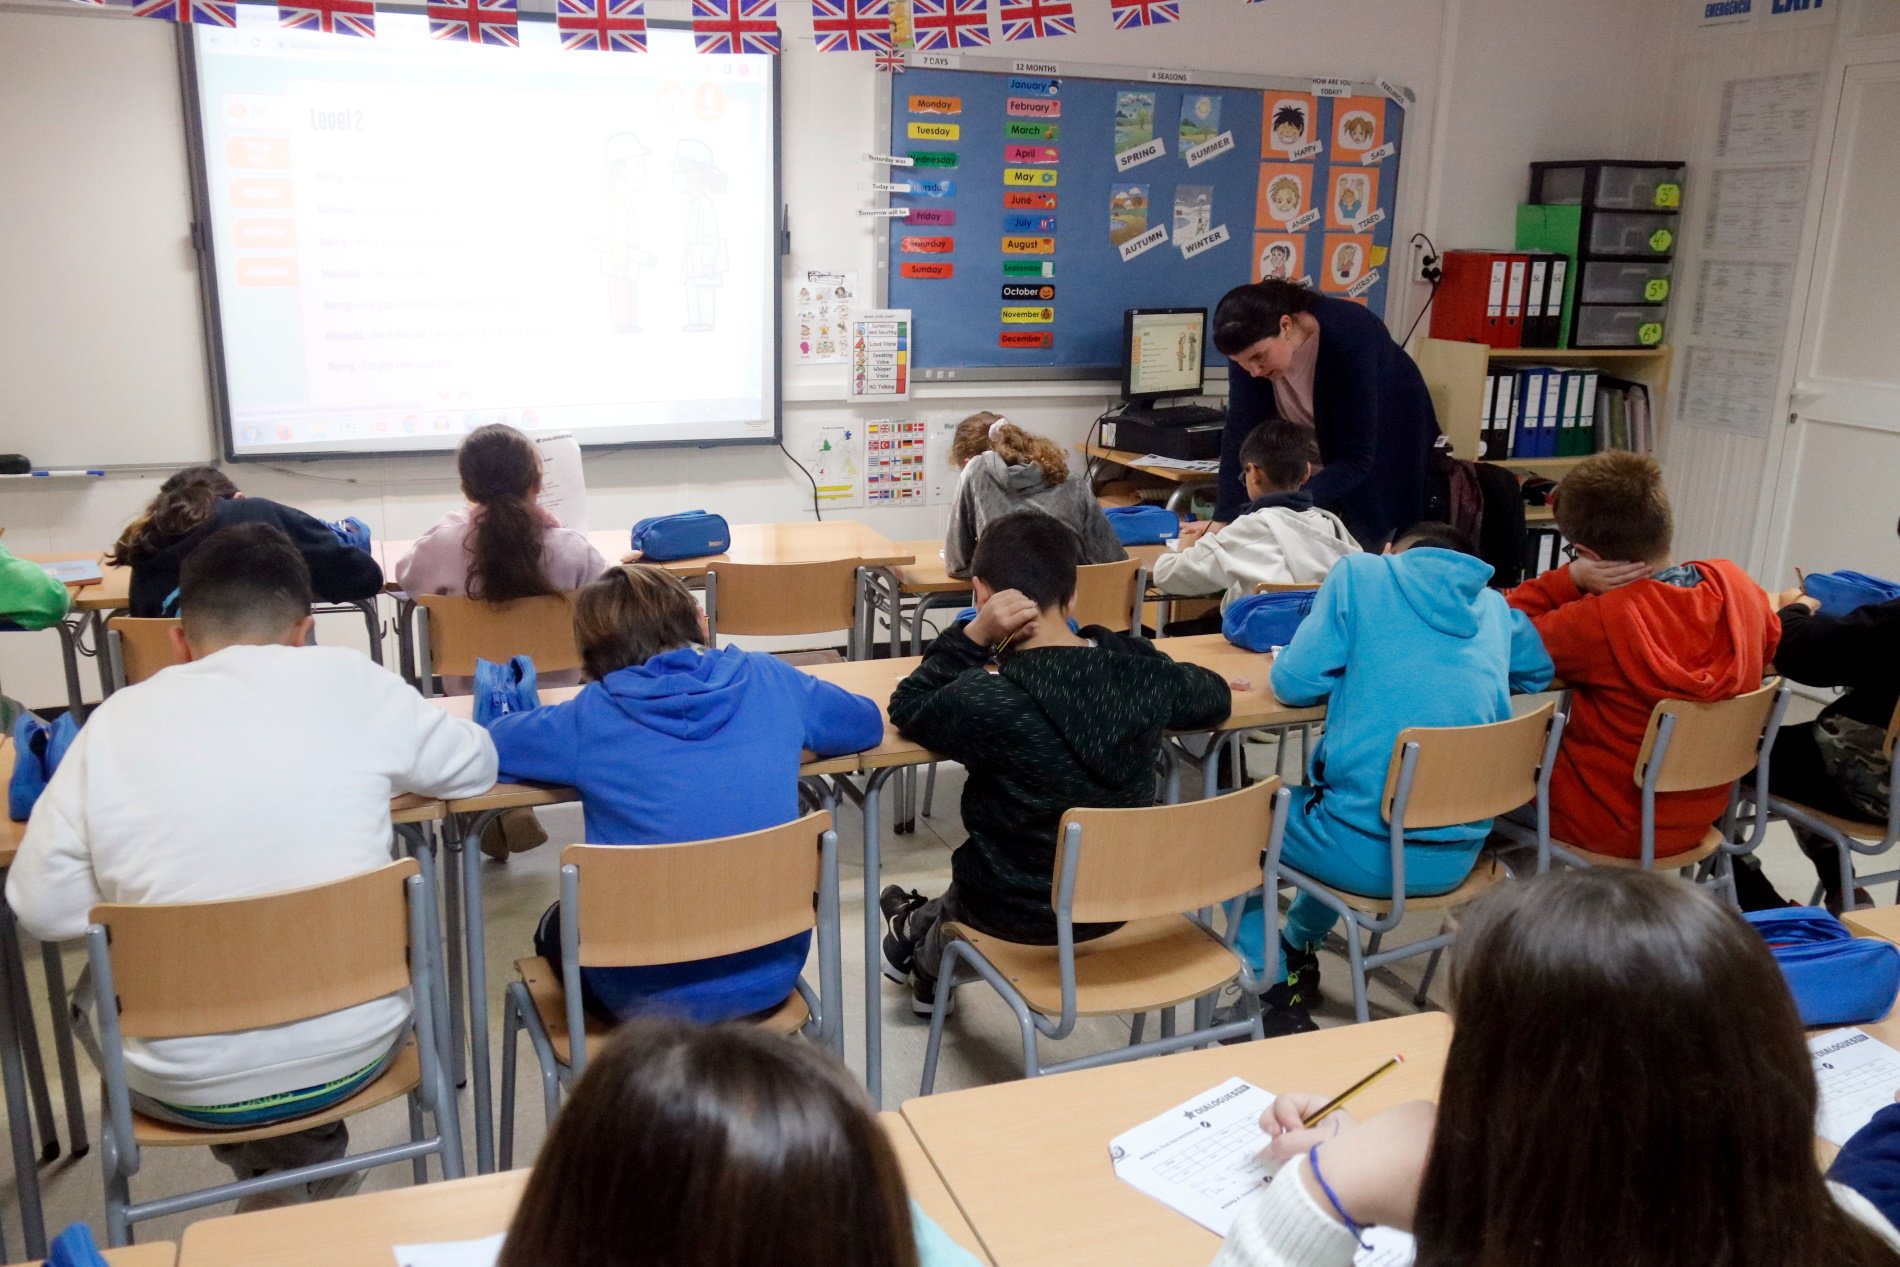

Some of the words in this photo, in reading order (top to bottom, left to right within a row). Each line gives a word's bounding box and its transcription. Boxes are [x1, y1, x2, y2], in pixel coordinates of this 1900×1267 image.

[923, 57, 929, 65] 7
[930, 57, 949, 66] DAYS
[1016, 63, 1025, 71] 12
[1026, 64, 1057, 73] MONTHS
[1157, 72, 1187, 81] SEASONS
[1010, 80, 1047, 91] January
[1380, 81, 1404, 104] FEELINGS
[917, 99, 952, 110] Monday
[1010, 101, 1050, 113] February
[310, 106, 351, 131] Level
[354, 109, 364, 131] 2
[916, 126, 951, 137] Tuesday
[1011, 125, 1040, 135] March
[1015, 148, 1036, 159] April
[1191, 137, 1230, 161] SUMMER
[1294, 144, 1316, 158] HAPPY
[1370, 149, 1386, 160] SAD
[868, 154, 893, 163] Yesterday
[1121, 146, 1156, 166] SPRING
[1014, 172, 1034, 182] May
[1011, 196, 1032, 205] June
[916, 212, 941, 222] Friday
[1014, 217, 1032, 228] July
[1292, 212, 1316, 229] ANGRY
[1358, 214, 1380, 229] TIRED
[1007, 239, 1038, 250] August
[1125, 230, 1163, 256] AUTUMN
[1185, 231, 1222, 253] WINTER
[911, 265, 942, 275] Sunday
[1003, 263, 1041, 274] September
[1348, 272, 1378, 295] THIRSTY
[1003, 287, 1038, 296] October
[1002, 310, 1039, 319] November
[1002, 334, 1041, 343] December
[1815, 1037, 1858, 1057] DIALOGUES
[1195, 1090, 1239, 1115] DIALOGUES
